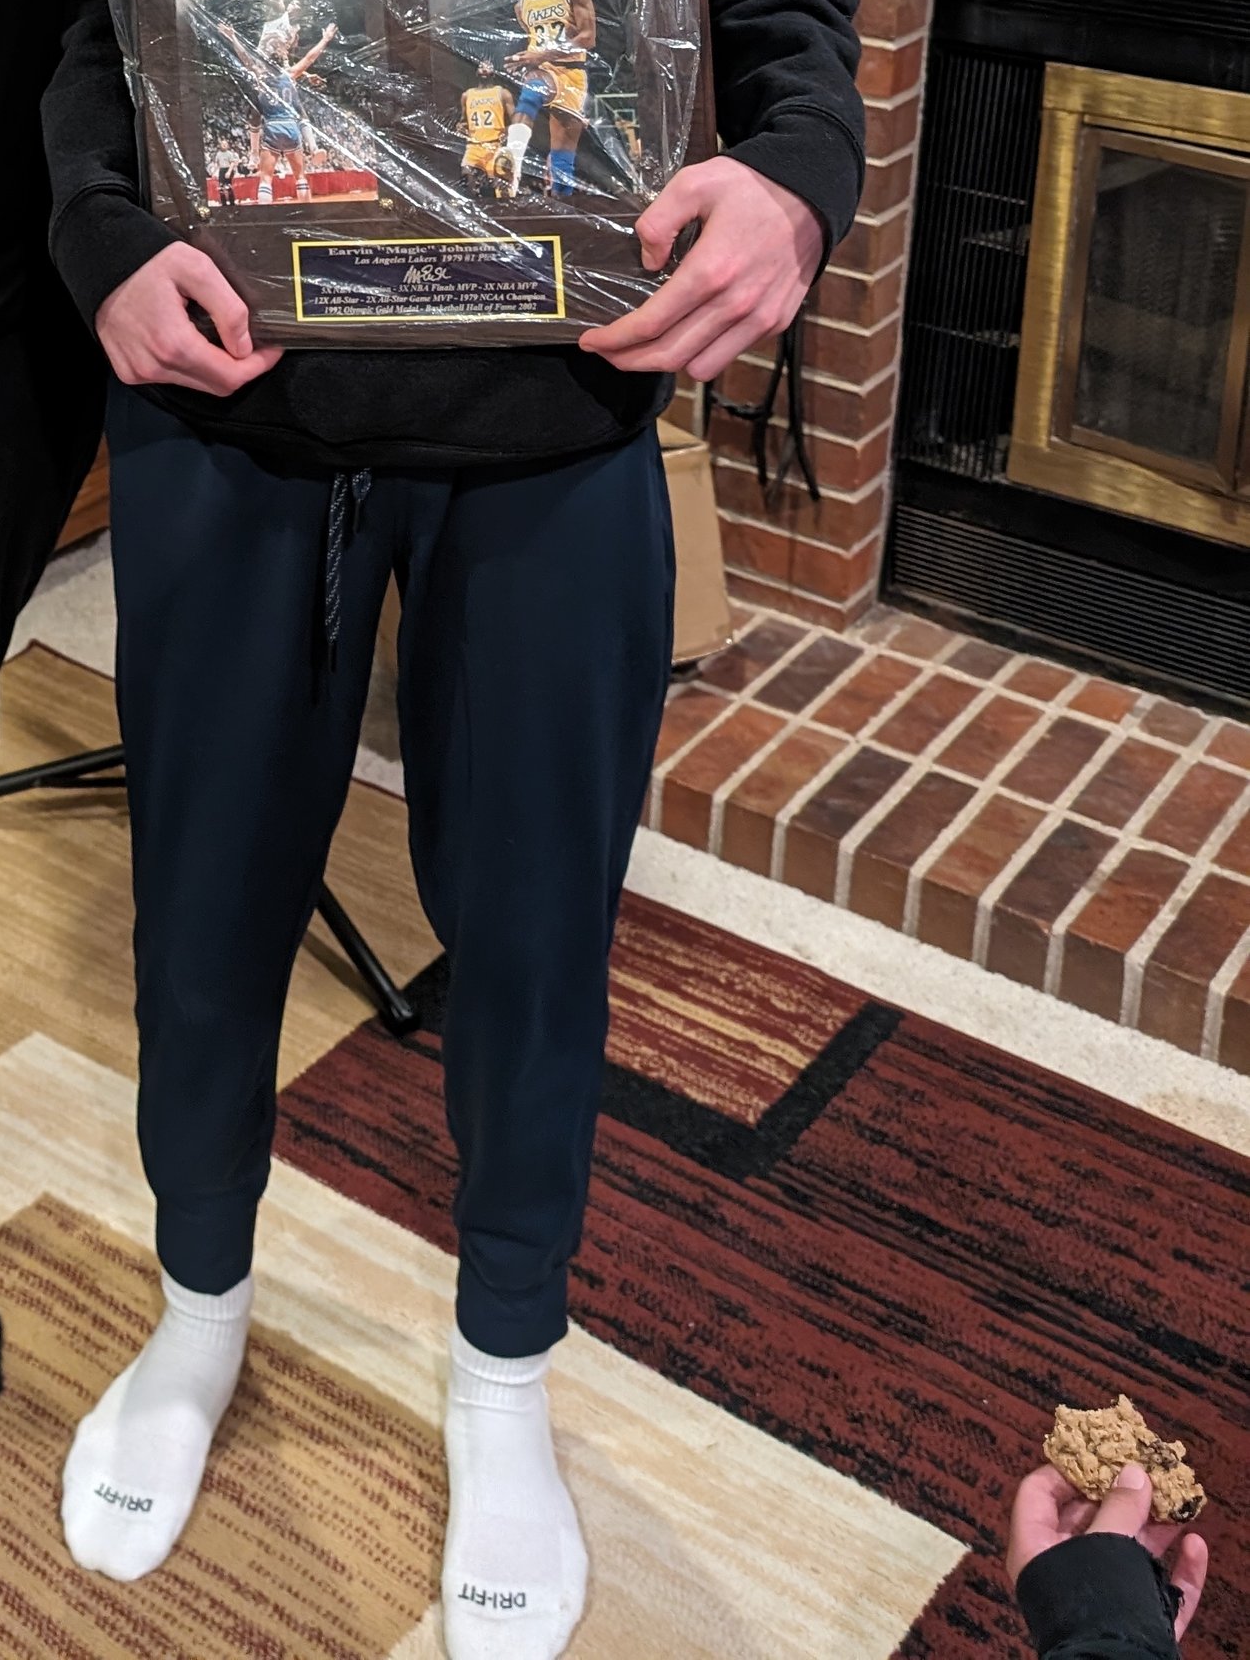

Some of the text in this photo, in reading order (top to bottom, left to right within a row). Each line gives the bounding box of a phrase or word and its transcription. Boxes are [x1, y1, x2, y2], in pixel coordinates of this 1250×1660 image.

[528, 4, 565, 27] LAKERS
[471, 110, 492, 126] 42
[328, 247, 374, 256] Earvin
[439, 244, 496, 253] Johnson
[354, 256, 370, 265] Los
[372, 256, 406, 265] Angeles
[407, 255, 437, 264] Lakers
[442, 253, 463, 263] 1979
[410, 284, 429, 292] NBA
[431, 283, 455, 291] Finals
[456, 283, 477, 291] MVP
[483, 282, 495, 291] 3X
[496, 282, 515, 290] NBA
[517, 282, 538, 290] MVP
[314, 296, 329, 305] 12X
[330, 296, 359, 305] All-Star
[365, 295, 377, 304] 2X
[377, 295, 407, 304] All-Star
[408, 295, 431, 303] Game
[432, 294, 454, 302] MVP
[460, 294, 478, 302] 1979
[479, 293, 505, 301] NCAA
[506, 293, 546, 301] Champion
[375, 306, 394, 314] Gold
[466, 303, 483, 311] Hall
[484, 303, 493, 312] of
[494, 303, 517, 311] Fame
[517, 302, 537, 310] 2002
[94, 1482, 153, 1511] DRI-FIT
[457, 1582, 526, 1609] DRI-FIT
